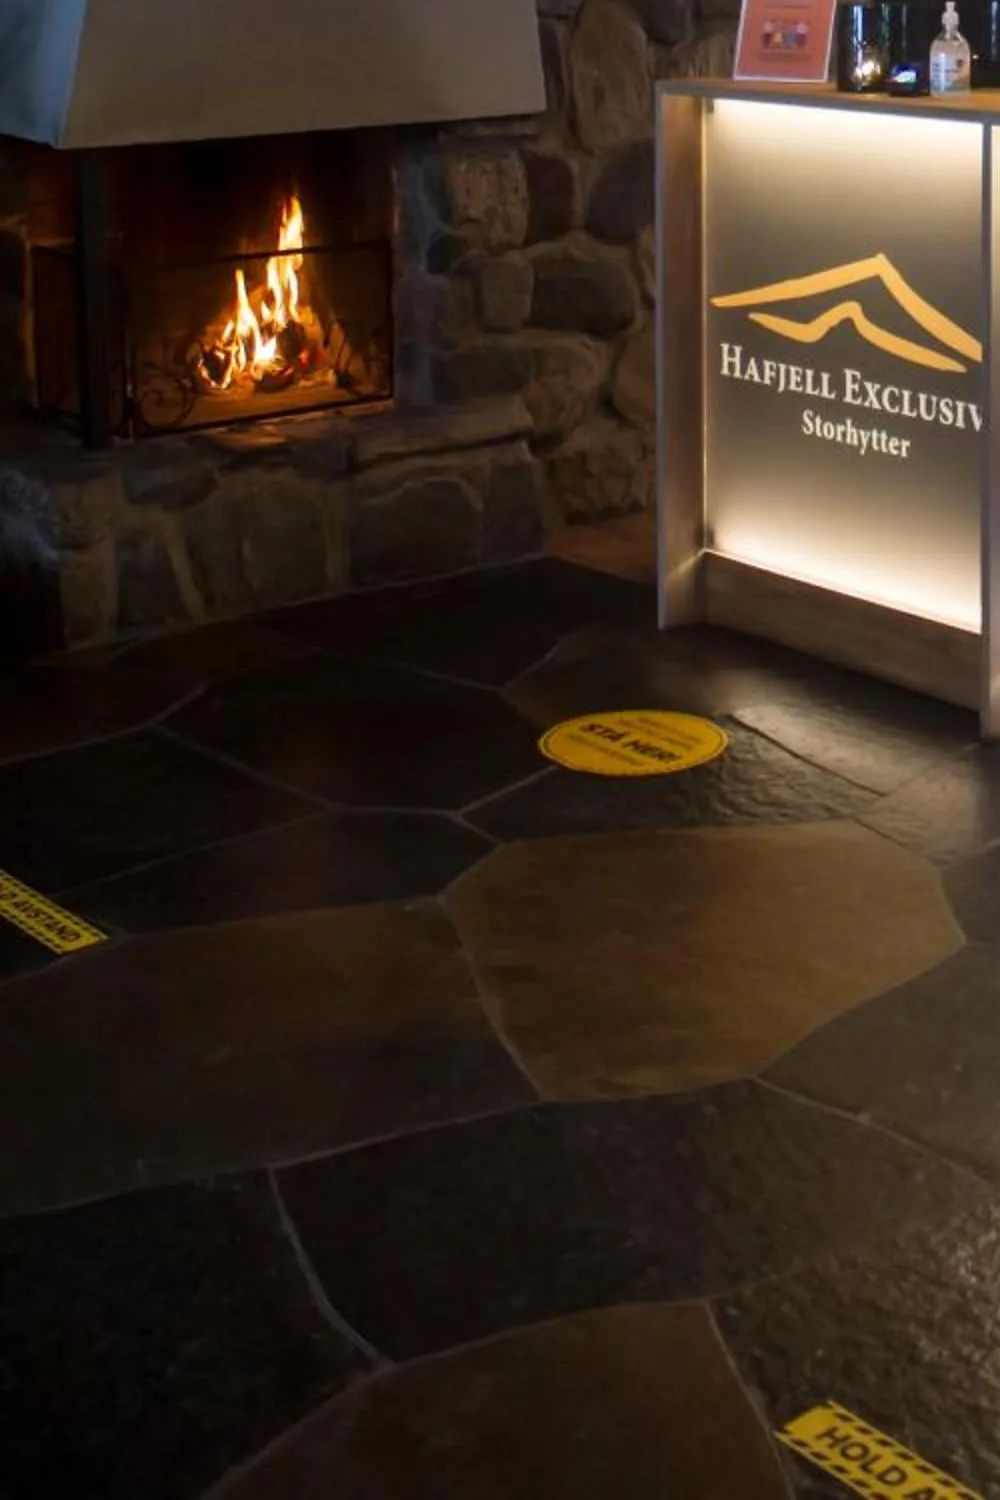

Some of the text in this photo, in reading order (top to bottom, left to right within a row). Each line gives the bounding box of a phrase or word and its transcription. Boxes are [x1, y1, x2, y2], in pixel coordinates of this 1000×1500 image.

[719, 343, 836, 399] HAFJELL
[803, 409, 911, 457] Storhytter
[814, 1425, 909, 1487] HOLD
